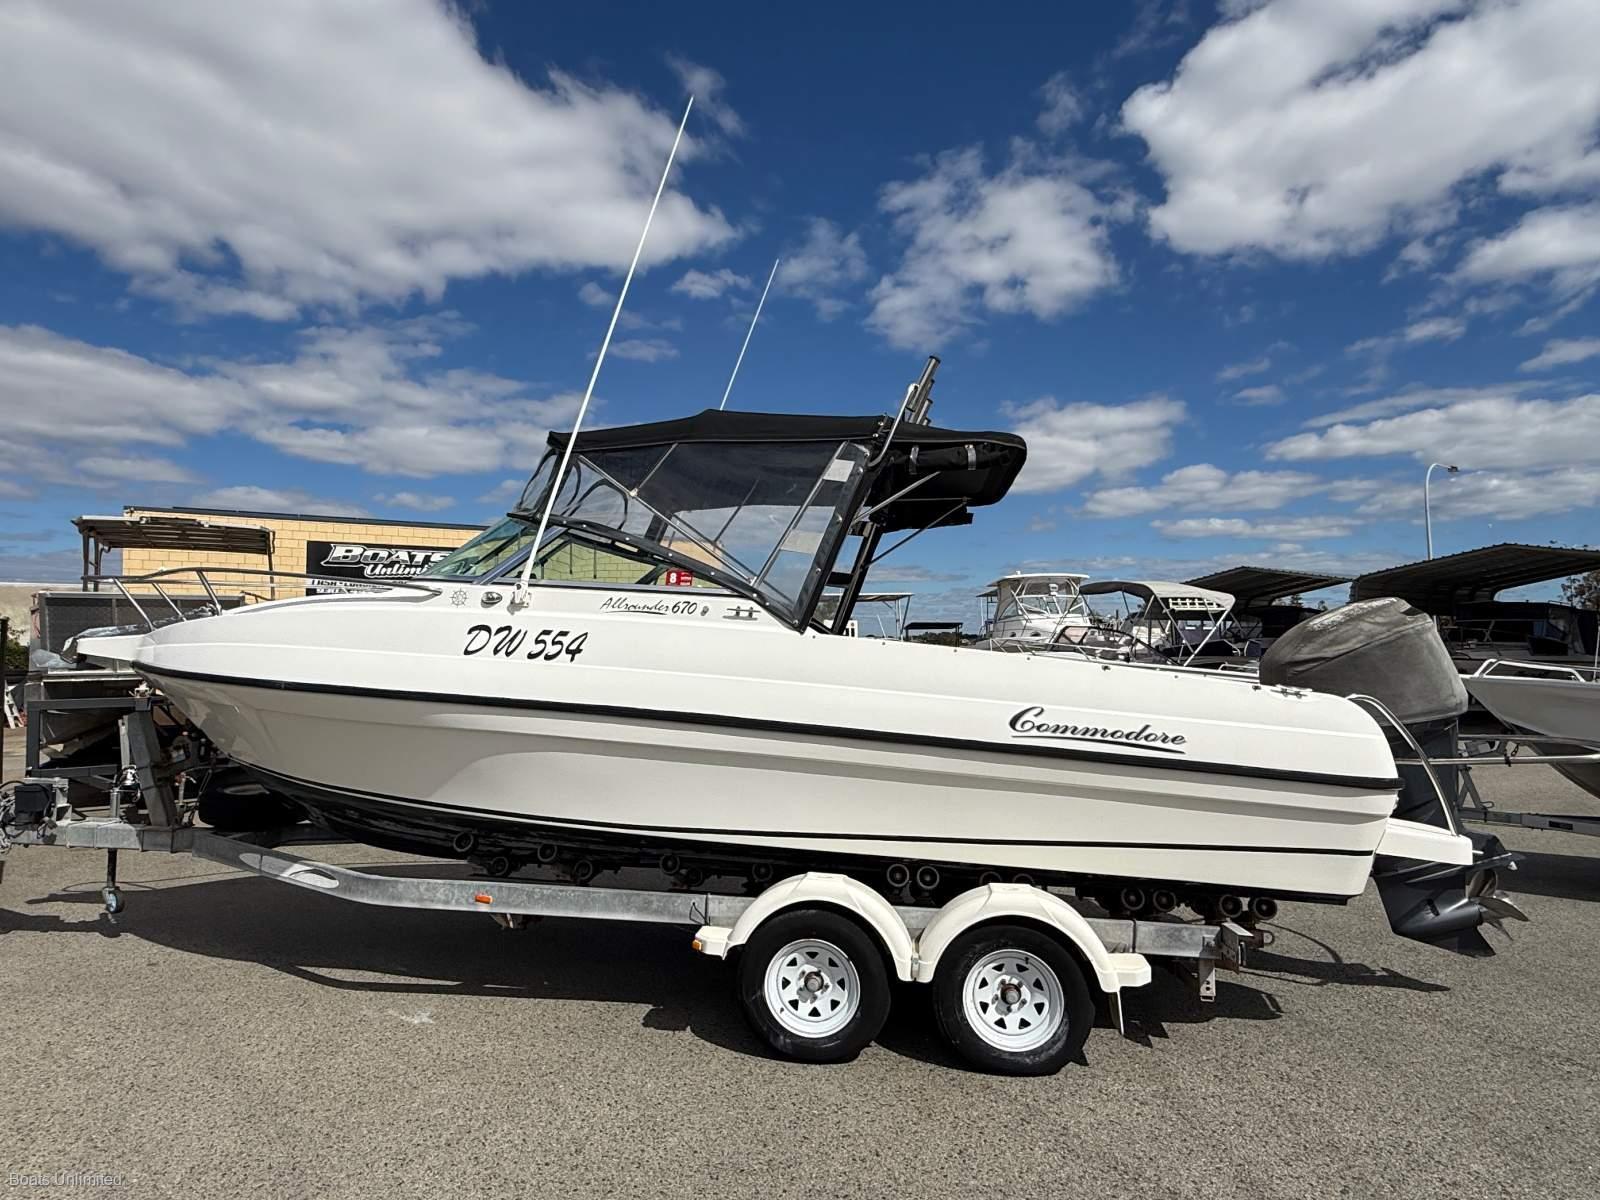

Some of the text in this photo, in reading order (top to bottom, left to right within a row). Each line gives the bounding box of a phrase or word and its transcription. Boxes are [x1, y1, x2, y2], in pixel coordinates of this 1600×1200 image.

[323, 544, 452, 567] BOATS
[364, 563, 430, 578] Unlimi
[600, 597, 698, 615] Allrounder 670
[463, 624, 589, 663] DW 554
[1008, 706, 1187, 746] Commodore
